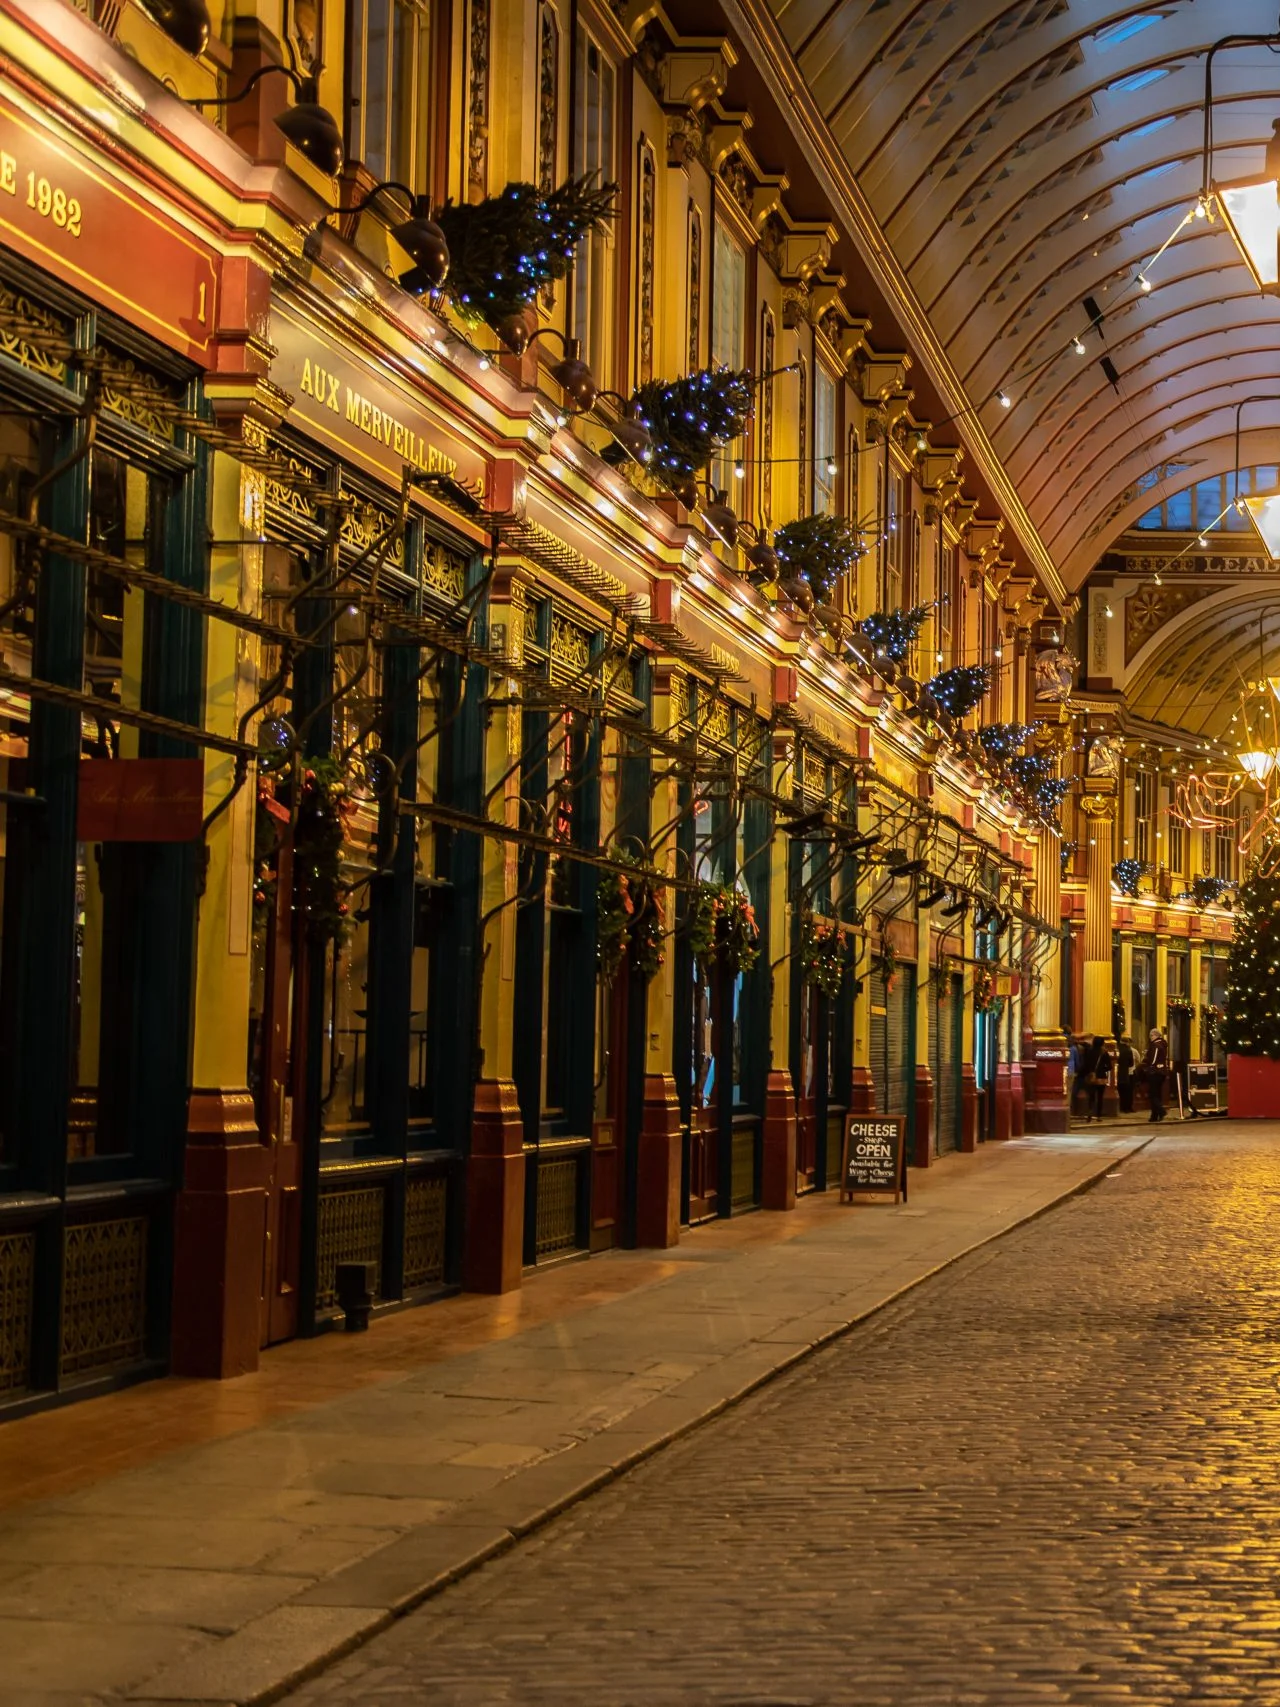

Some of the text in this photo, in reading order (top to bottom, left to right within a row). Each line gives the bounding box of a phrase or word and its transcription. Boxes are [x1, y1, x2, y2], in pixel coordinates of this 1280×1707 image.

[26, 171, 82, 238] 1982
[197, 281, 206, 323] 1
[300, 358, 457, 479] AUX MERVEILLEUX
[850, 1123, 897, 1136] CHEESE
[849, 1159, 881, 1167] Available
[856, 1144, 891, 1157] OPEN
